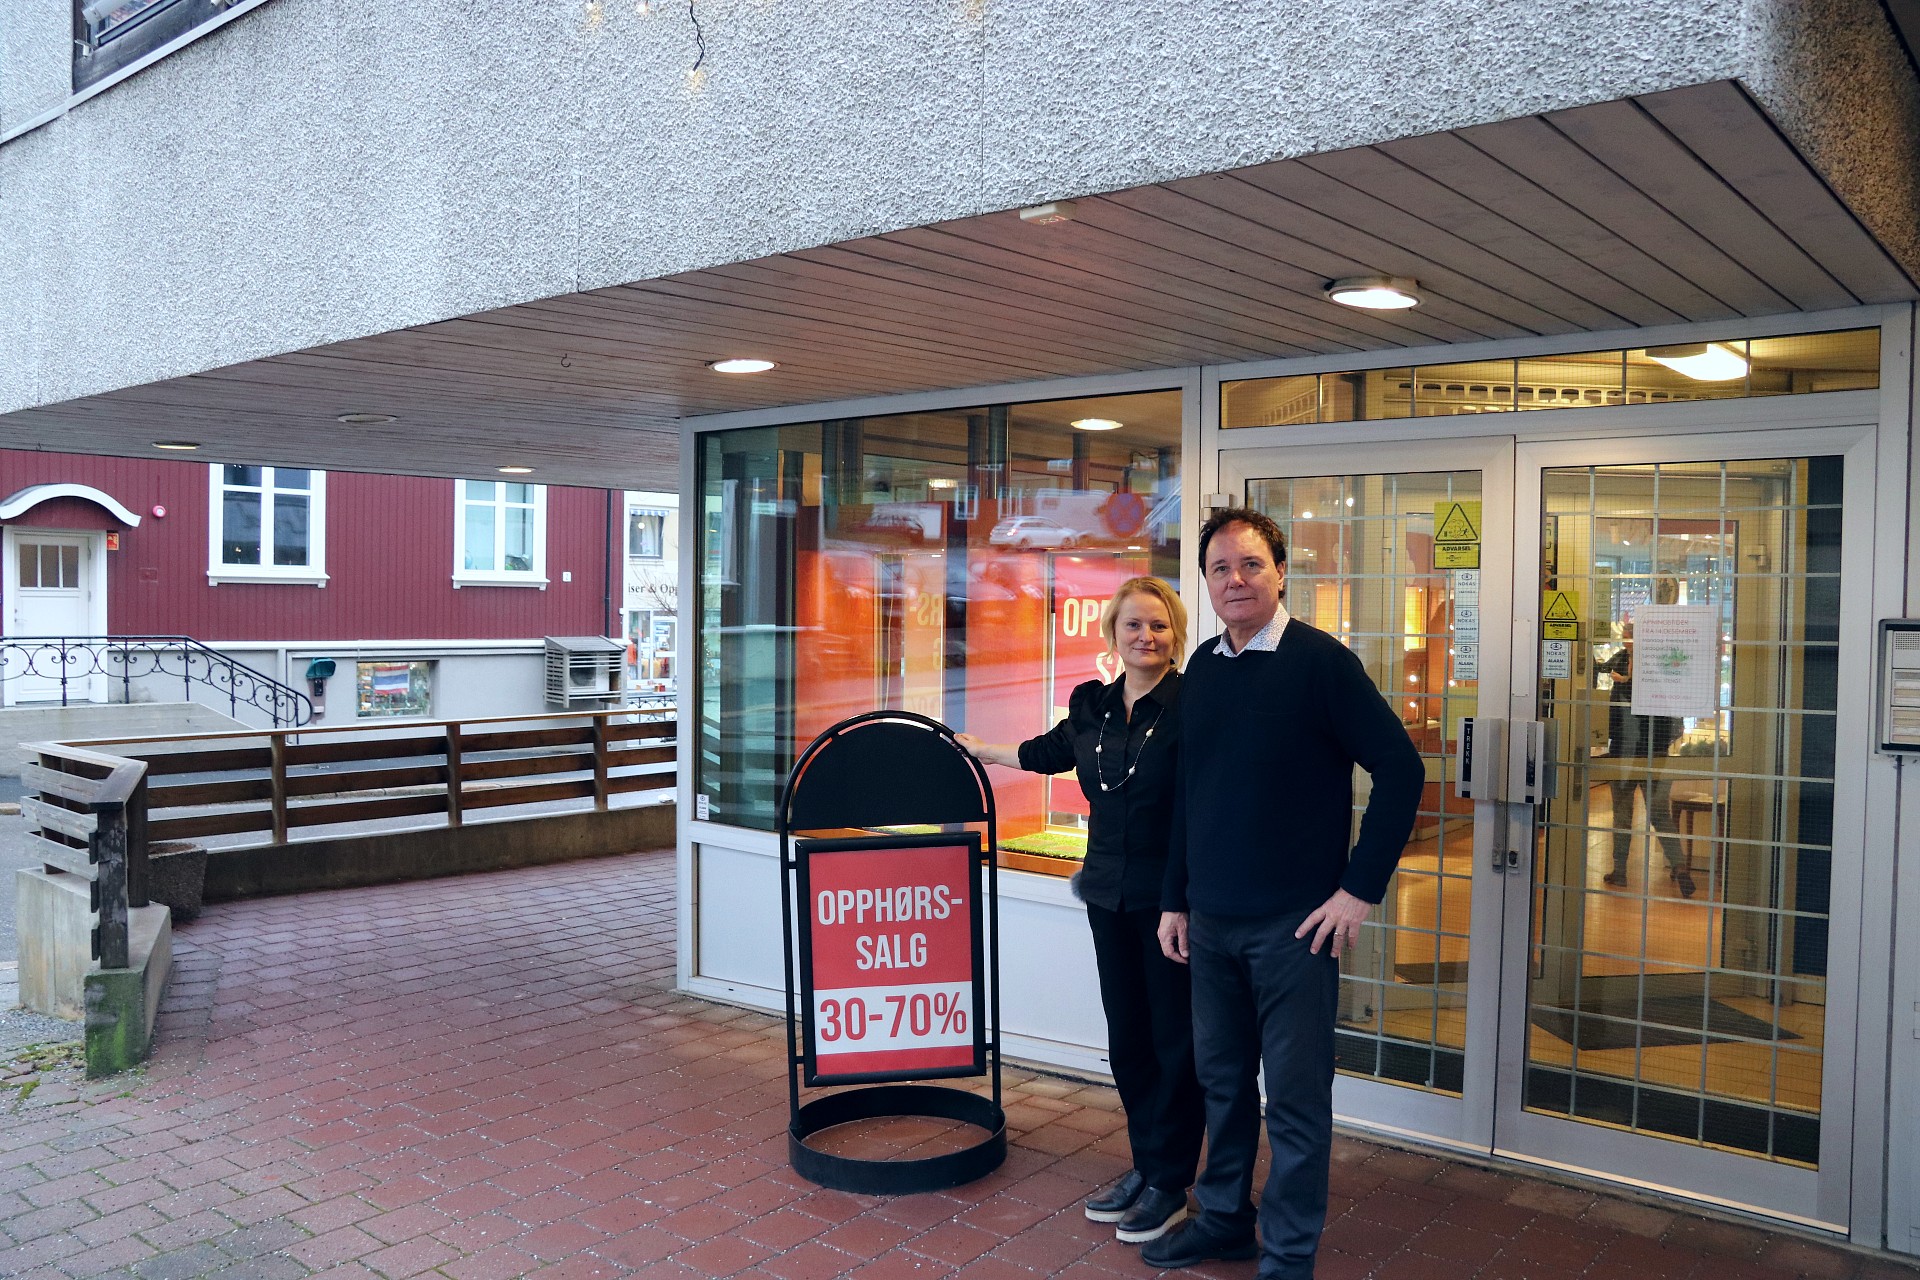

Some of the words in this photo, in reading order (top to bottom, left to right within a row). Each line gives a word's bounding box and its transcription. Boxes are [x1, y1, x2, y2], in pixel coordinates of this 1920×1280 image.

[817, 885, 963, 925] OPPHØRS-
[856, 932, 927, 970] SALG
[819, 991, 967, 1042] 30-70%
